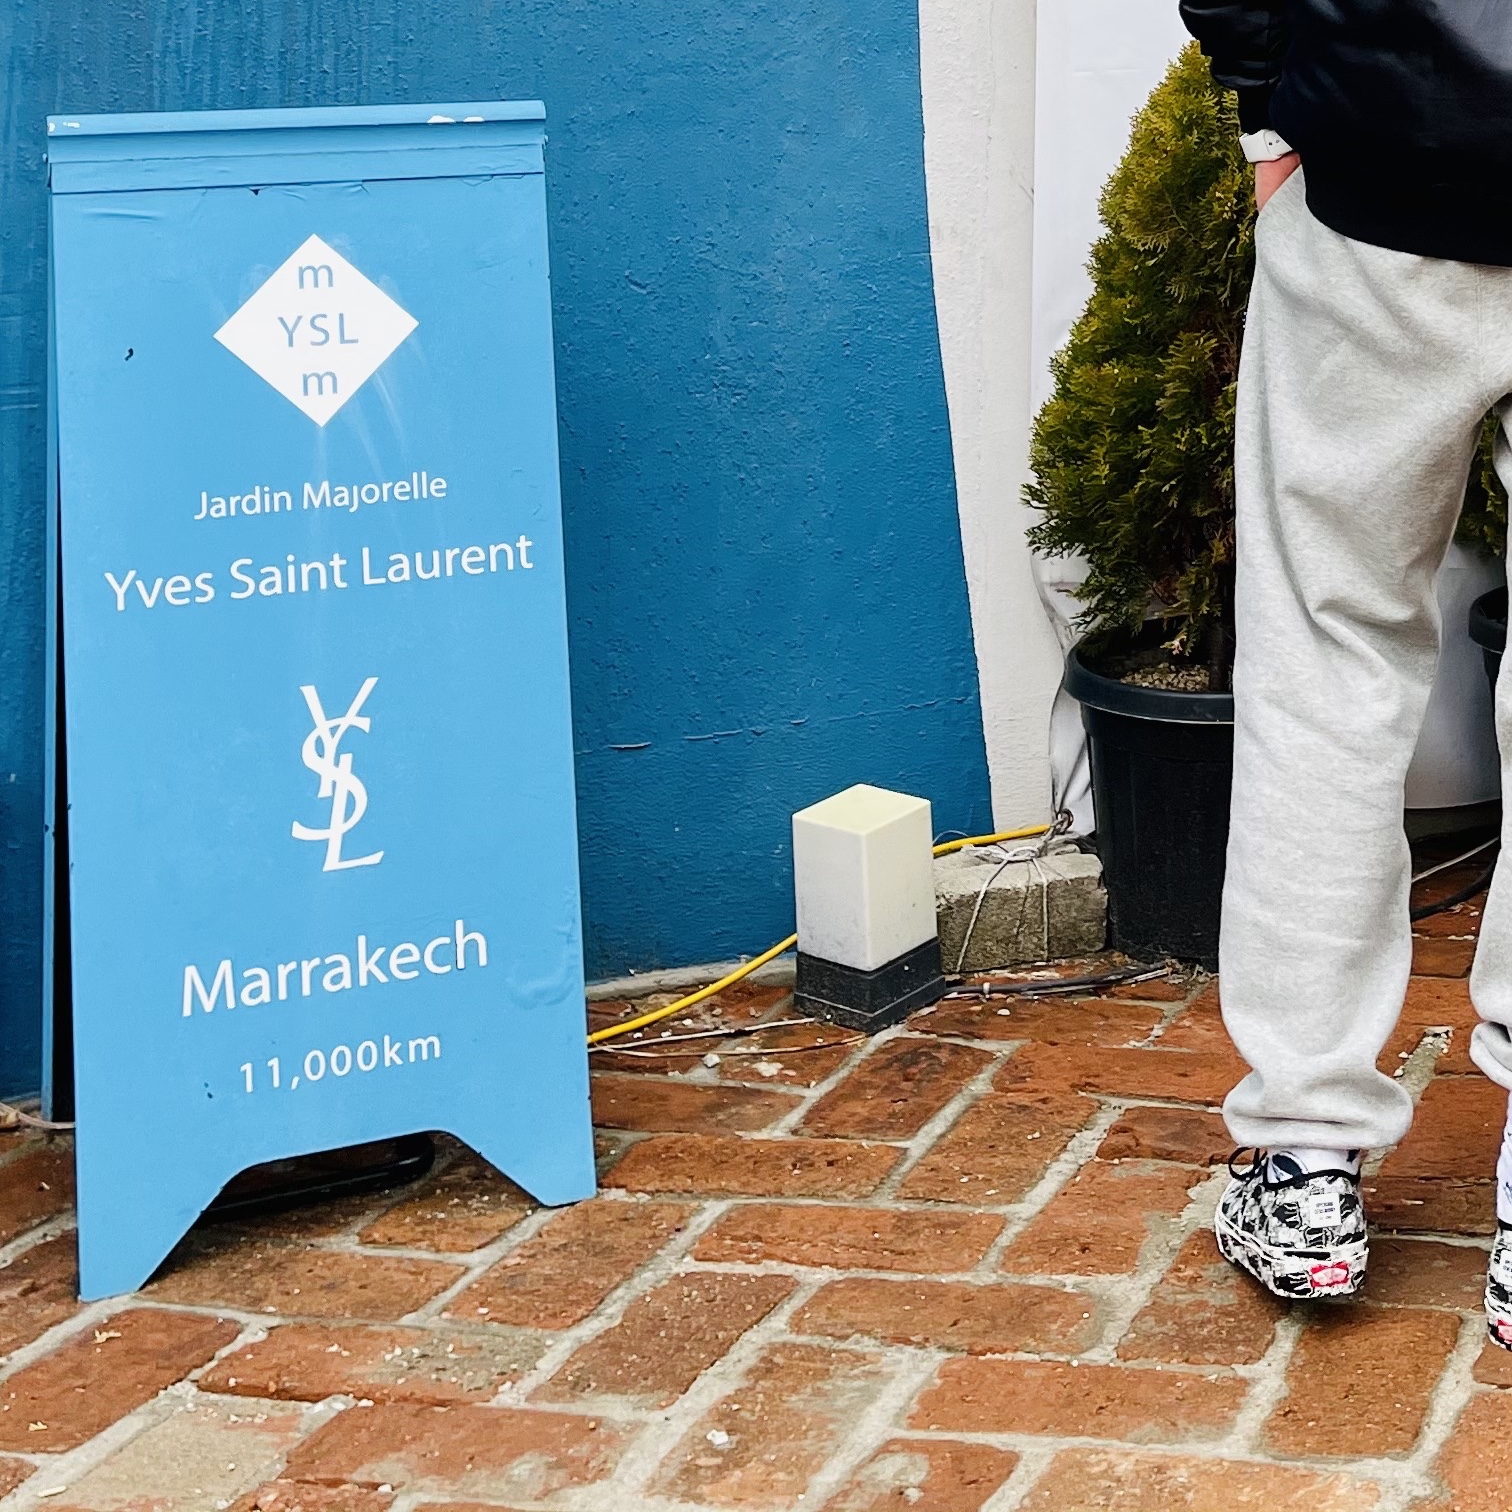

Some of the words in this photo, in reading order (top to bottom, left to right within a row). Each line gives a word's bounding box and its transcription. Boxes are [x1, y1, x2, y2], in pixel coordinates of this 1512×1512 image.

[298, 264, 334, 290] m
[278, 312, 359, 348] YSL
[302, 371, 338, 397] m
[194, 485, 292, 520] Jardin
[302, 471, 447, 513] Majorelle
[104, 569, 215, 611] Yves
[230, 552, 348, 599] Saint
[362, 534, 534, 585] Laurent
[182, 919, 488, 1017] Marrakech
[240, 1034, 441, 1093] 11,000km
